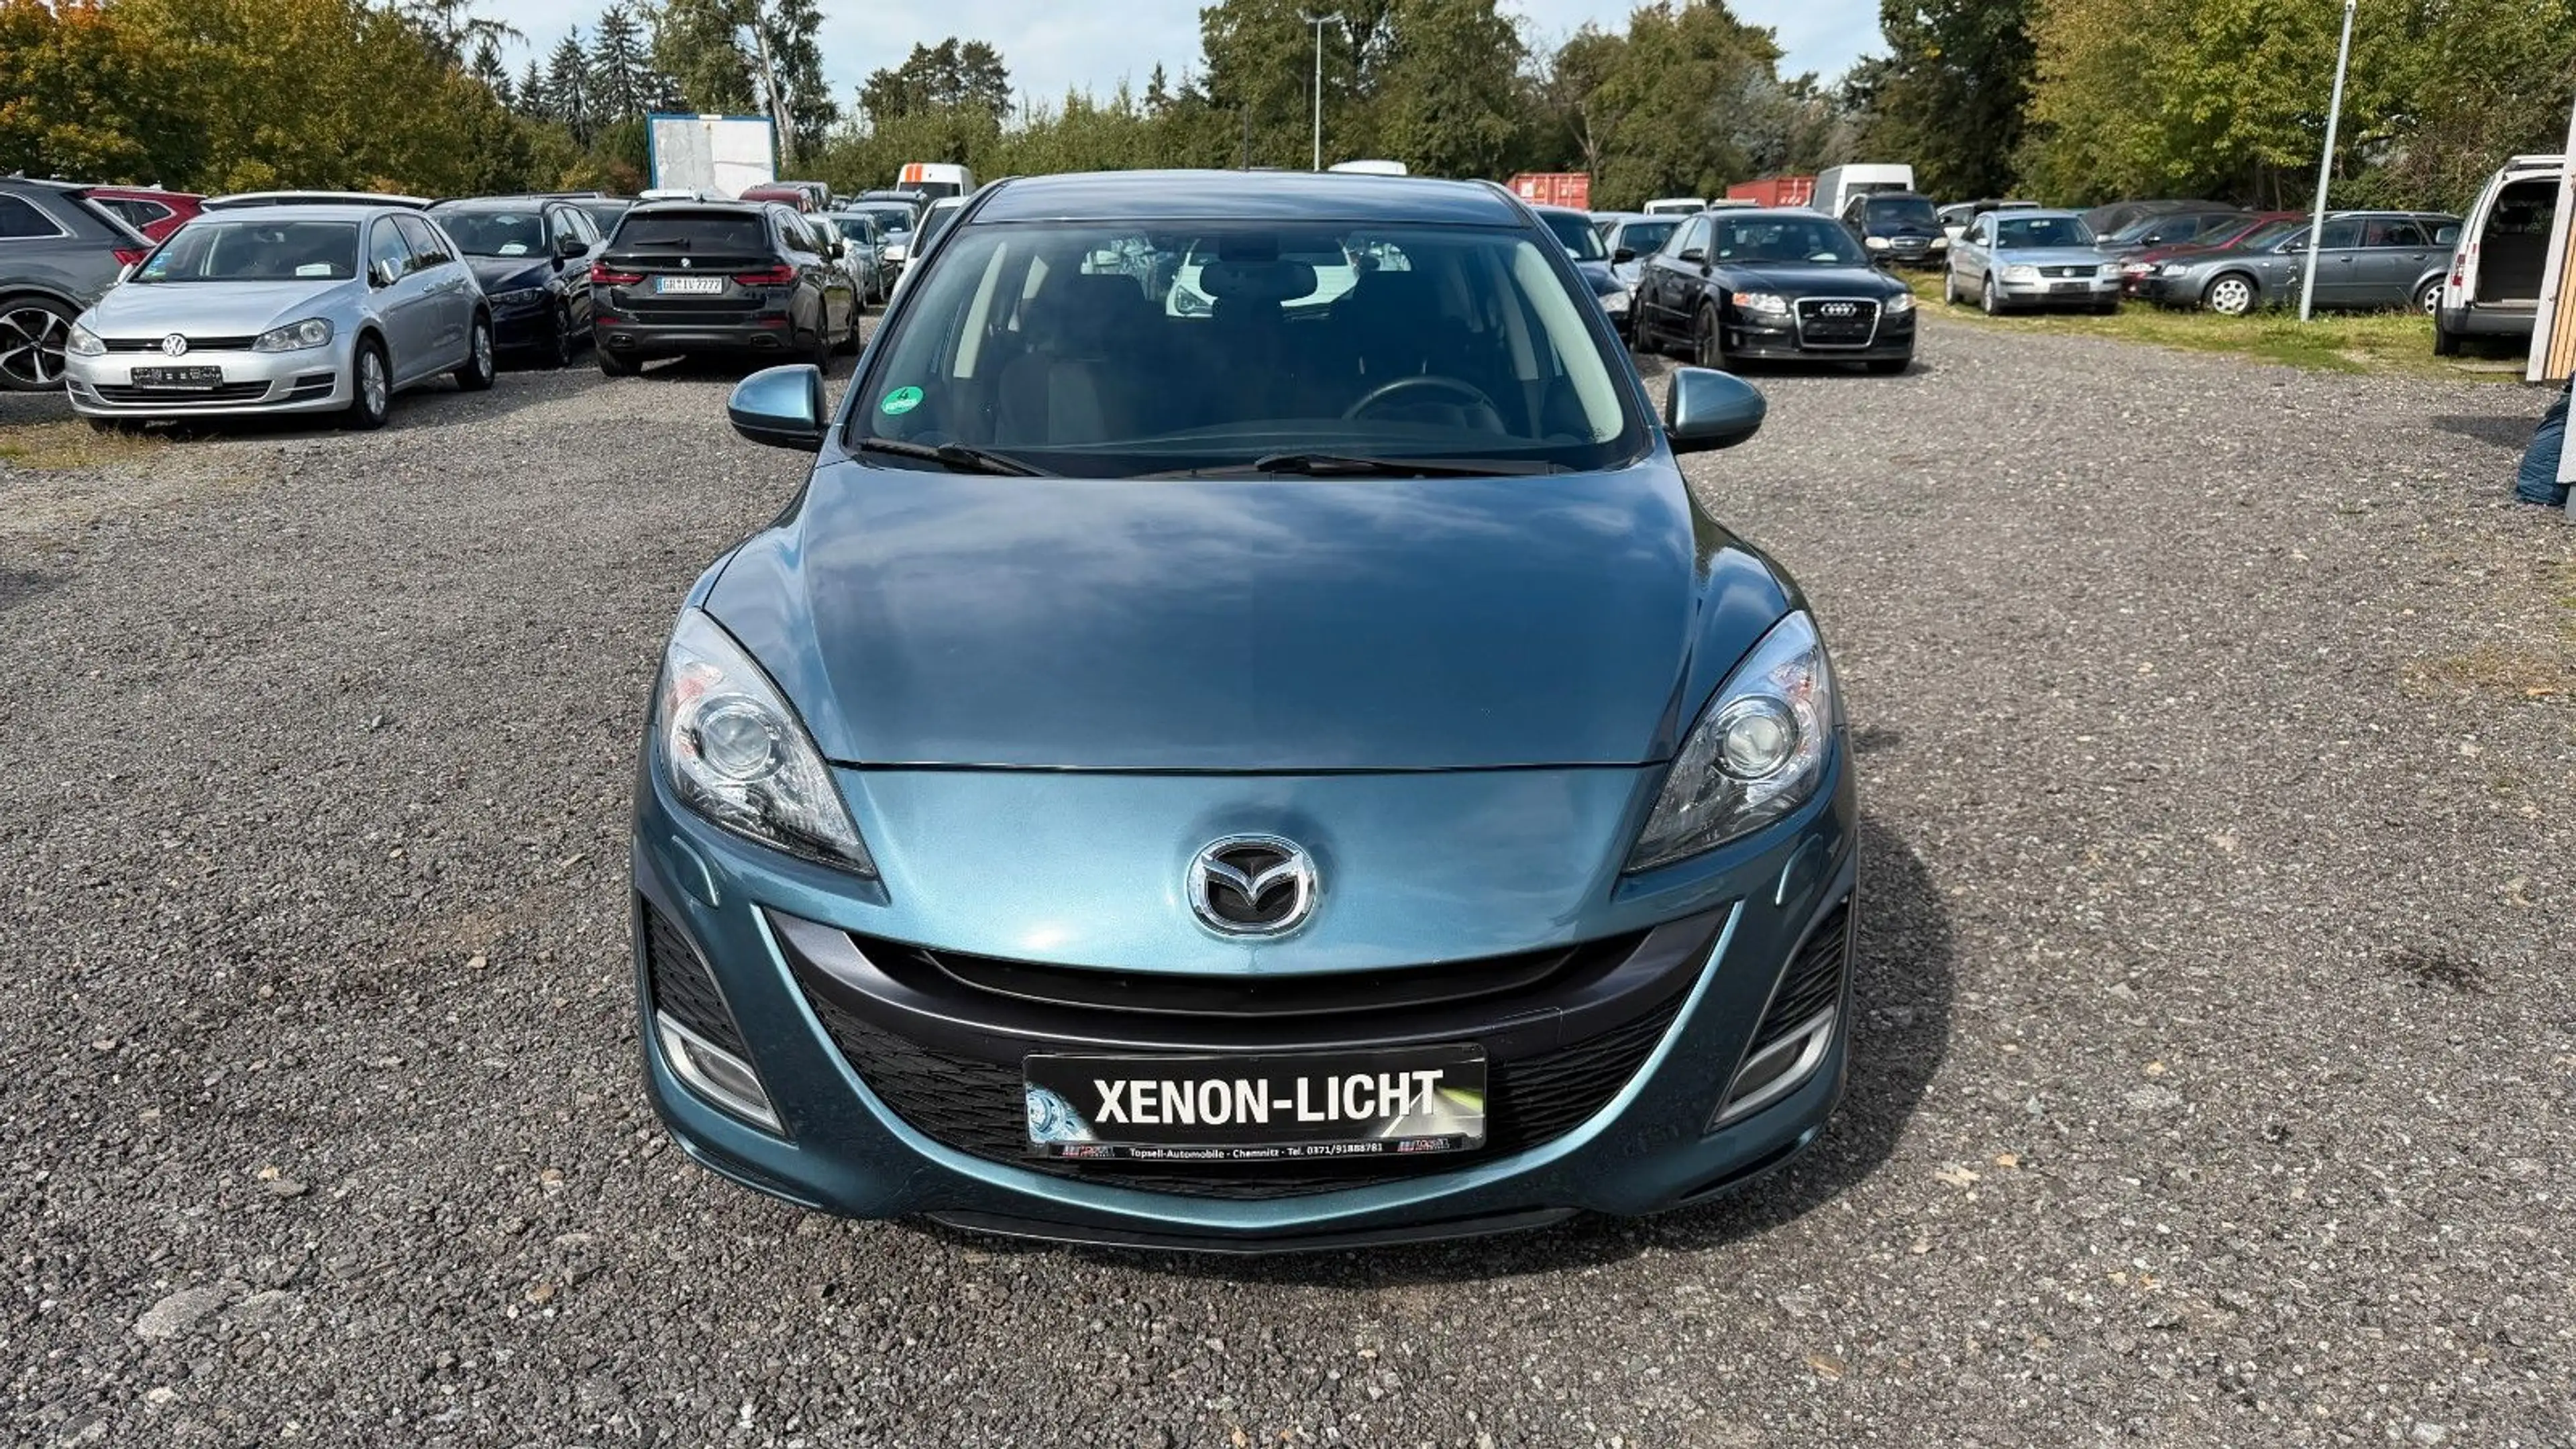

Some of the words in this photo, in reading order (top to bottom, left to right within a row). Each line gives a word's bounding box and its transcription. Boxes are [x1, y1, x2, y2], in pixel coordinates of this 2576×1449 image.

[897, 388, 909, 400] 4
[1093, 1069, 1444, 1125] XENON-LICHT
[1129, 1146, 1225, 1161] Topsell-Automobile
[1232, 1147, 1280, 1159] Chemnitz
[1286, 1146, 1304, 1157] Tel.
